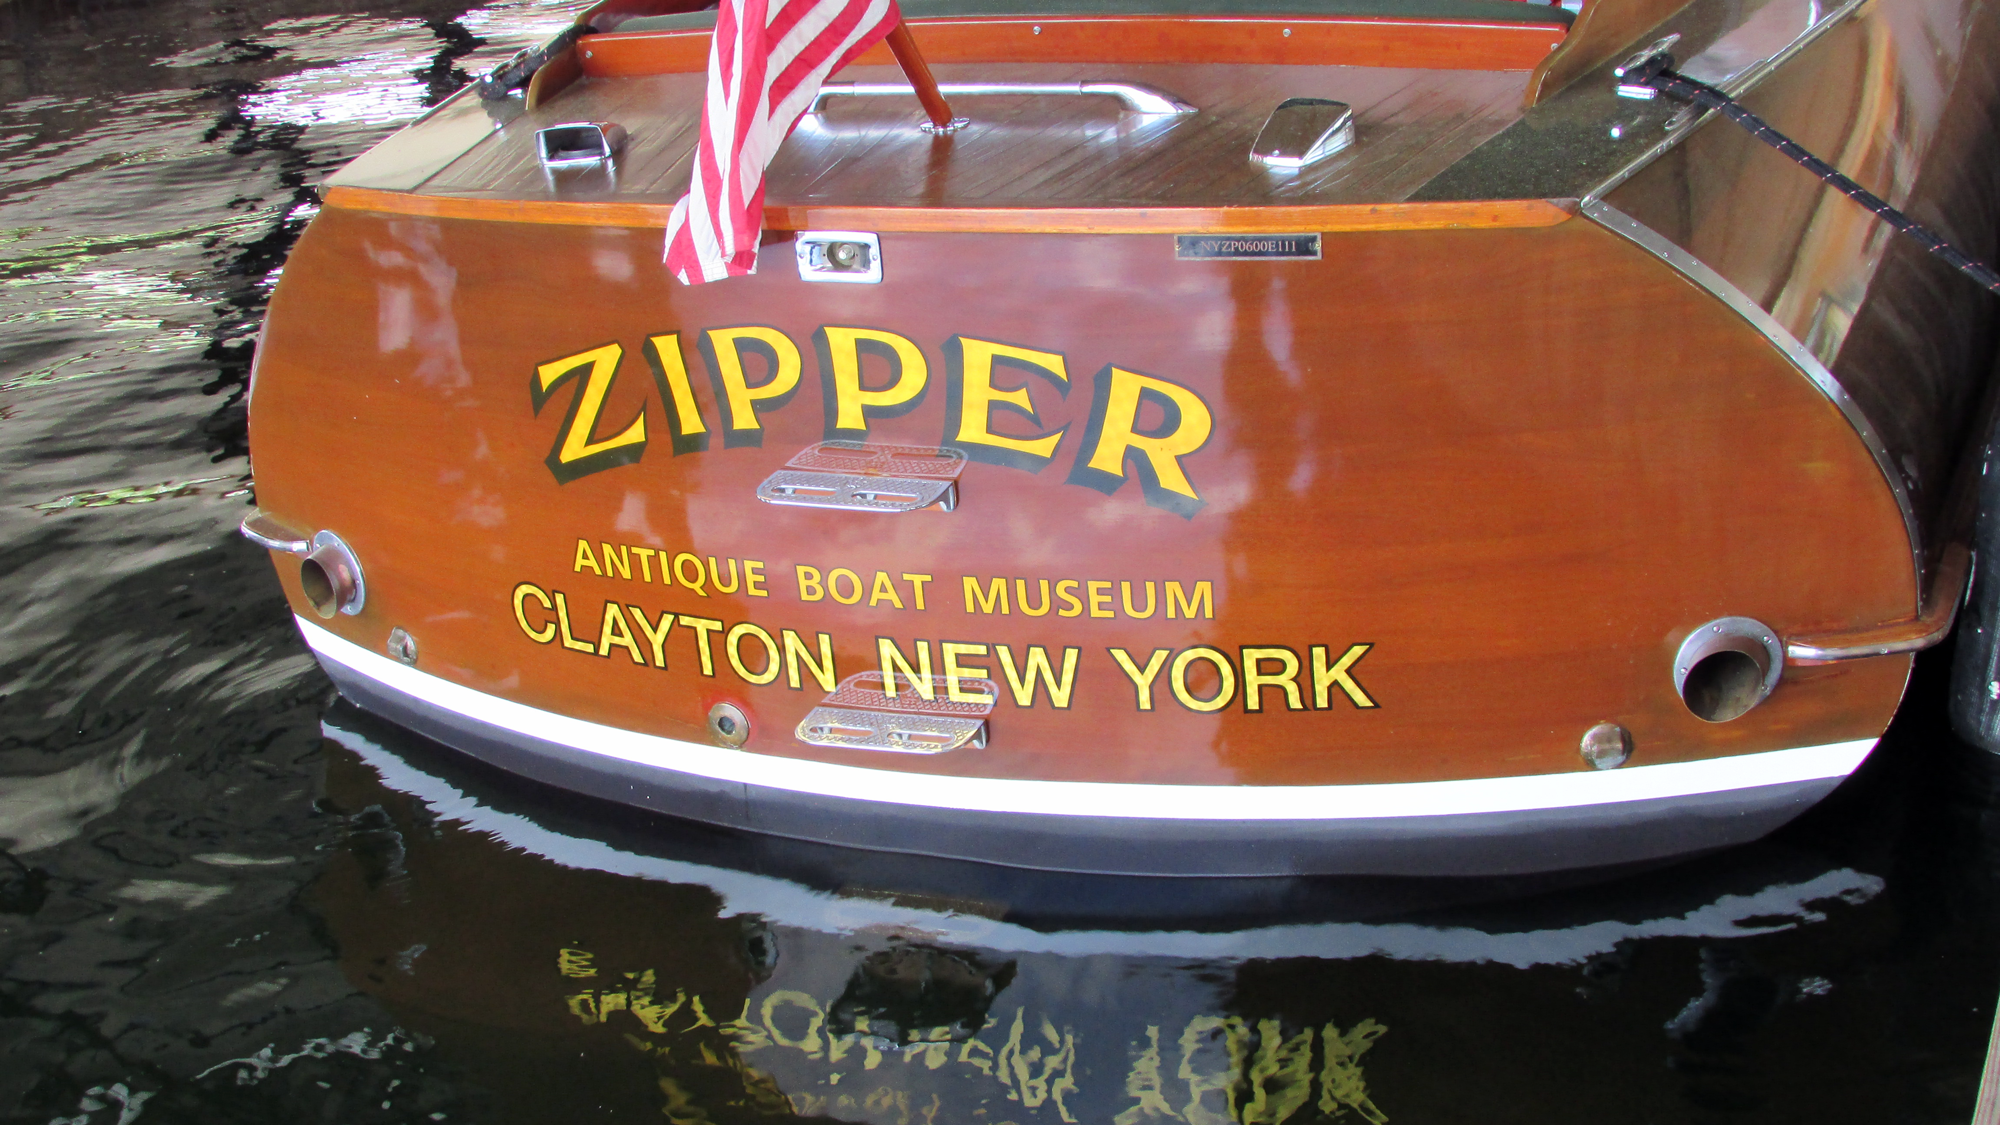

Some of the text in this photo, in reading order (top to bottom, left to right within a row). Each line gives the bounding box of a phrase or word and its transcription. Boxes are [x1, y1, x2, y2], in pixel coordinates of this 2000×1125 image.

[532, 324, 1213, 520] ZIPPER
[574, 538, 1214, 619] ANTIQUE BOAT MUSEUM
[512, 582, 1380, 713] CLAYTON NEW YORK
